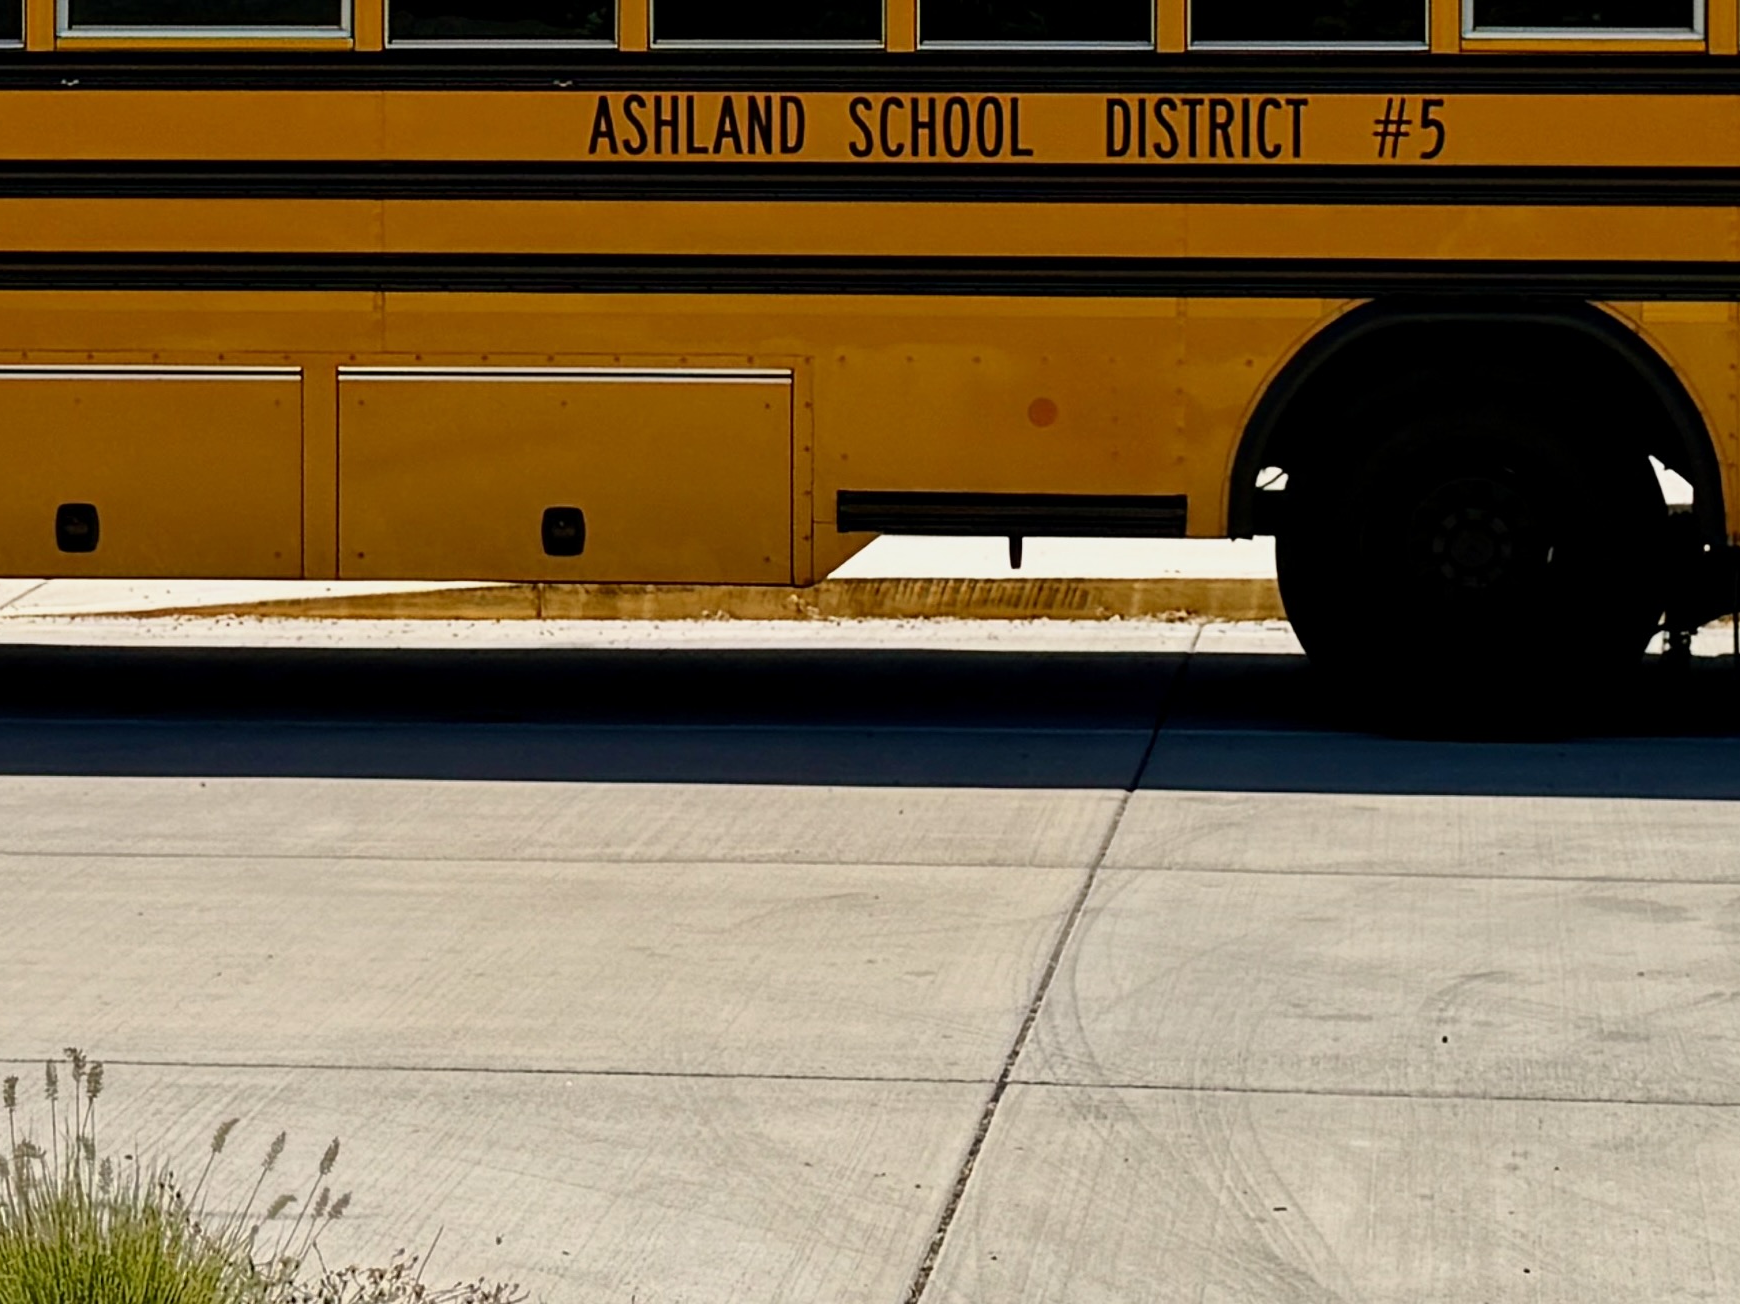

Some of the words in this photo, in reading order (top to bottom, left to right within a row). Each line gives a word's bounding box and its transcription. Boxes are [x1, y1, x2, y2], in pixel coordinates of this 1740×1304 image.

[588, 94, 806, 156] ASHLAND
[848, 96, 1034, 158] SCHOOL
[1105, 97, 1309, 159] DISTRICT
[1372, 97, 1446, 160] #5
